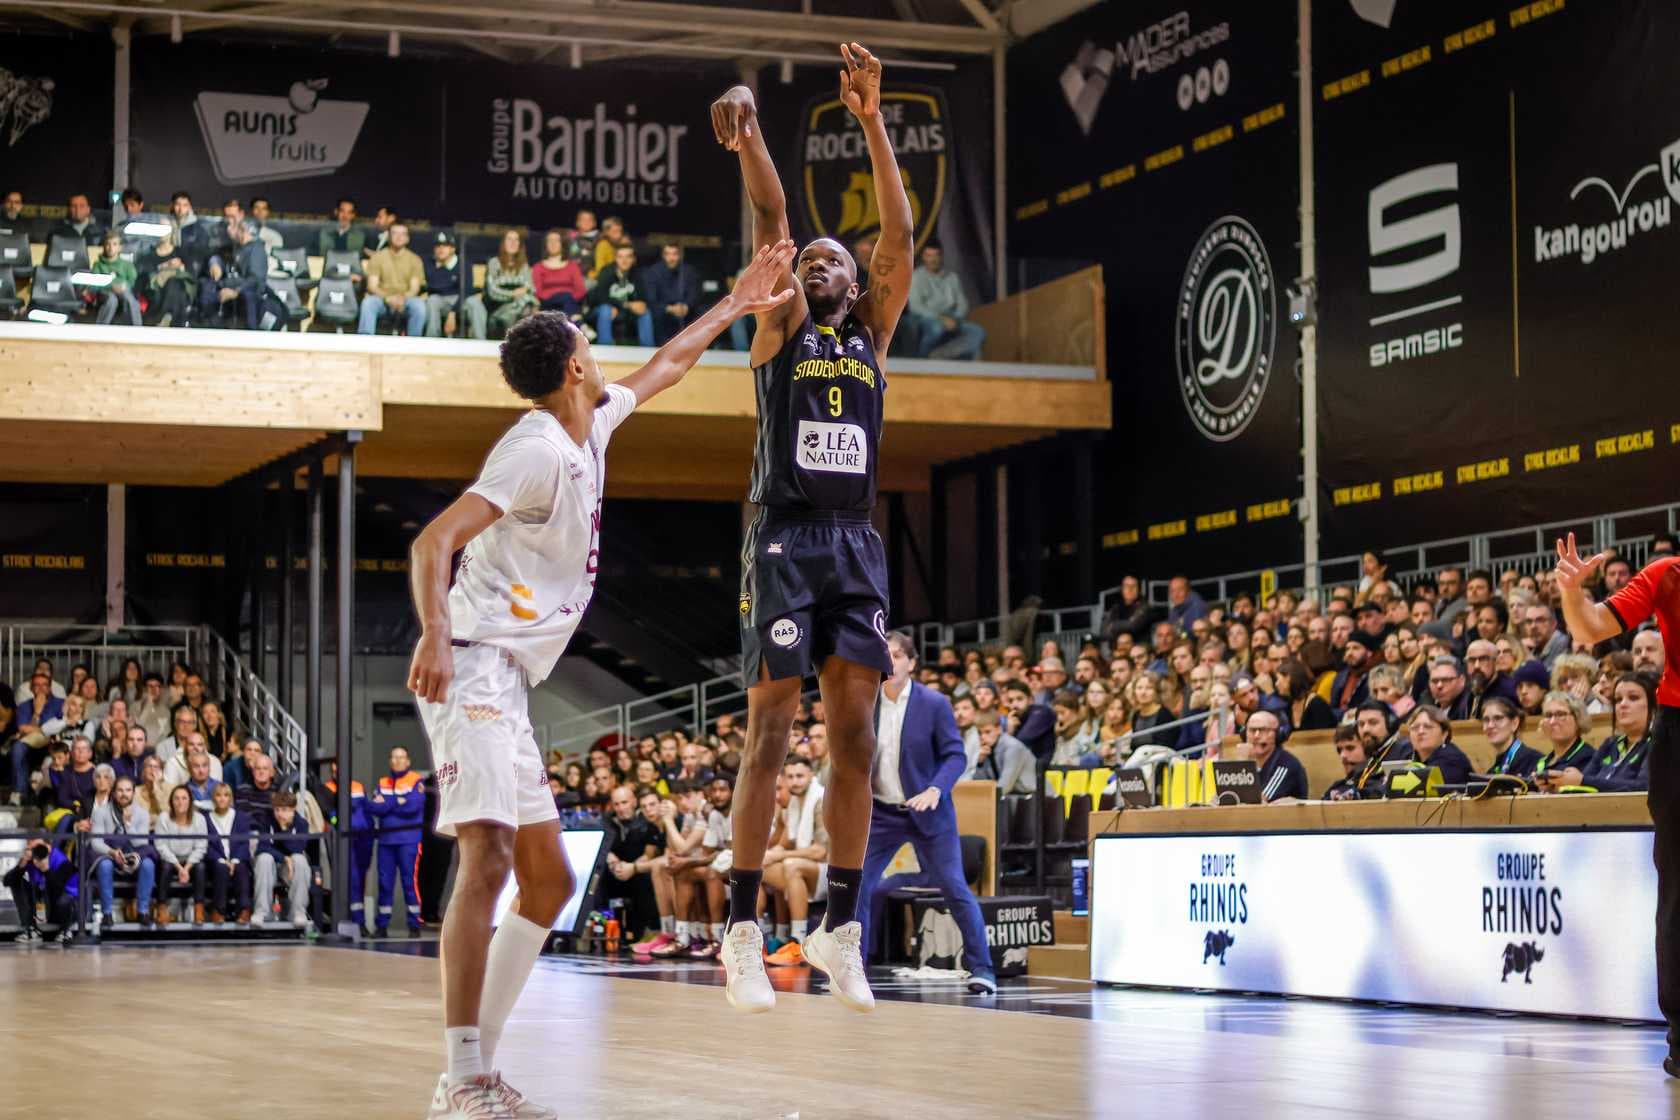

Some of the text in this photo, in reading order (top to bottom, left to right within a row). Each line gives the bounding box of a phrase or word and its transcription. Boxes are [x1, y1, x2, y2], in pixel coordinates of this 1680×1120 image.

[223, 110, 298, 137] AUNIS
[487, 98, 511, 174] Groupe
[271, 135, 327, 163] fruits
[513, 98, 688, 183] Barbier
[805, 124, 945, 162] ROCHLAIS
[513, 176, 680, 207] AUTOMOBILES
[1535, 196, 1671, 264] kangourou
[1370, 323, 1463, 367] SAMSIC
[828, 386, 843, 417] 9
[827, 427, 860, 452] LÉA
[805, 450, 860, 467] NATURE
[774, 626, 795, 638] RAS
[1216, 768, 1255, 785] koesio
[1201, 853, 1236, 877] GROUPE
[1497, 852, 1545, 880] GROUPE
[997, 906, 1037, 922] GROUPE
[1190, 882, 1248, 924] RHINOS
[1482, 886, 1562, 936] RHINOS
[985, 920, 1052, 947] RHINOS
